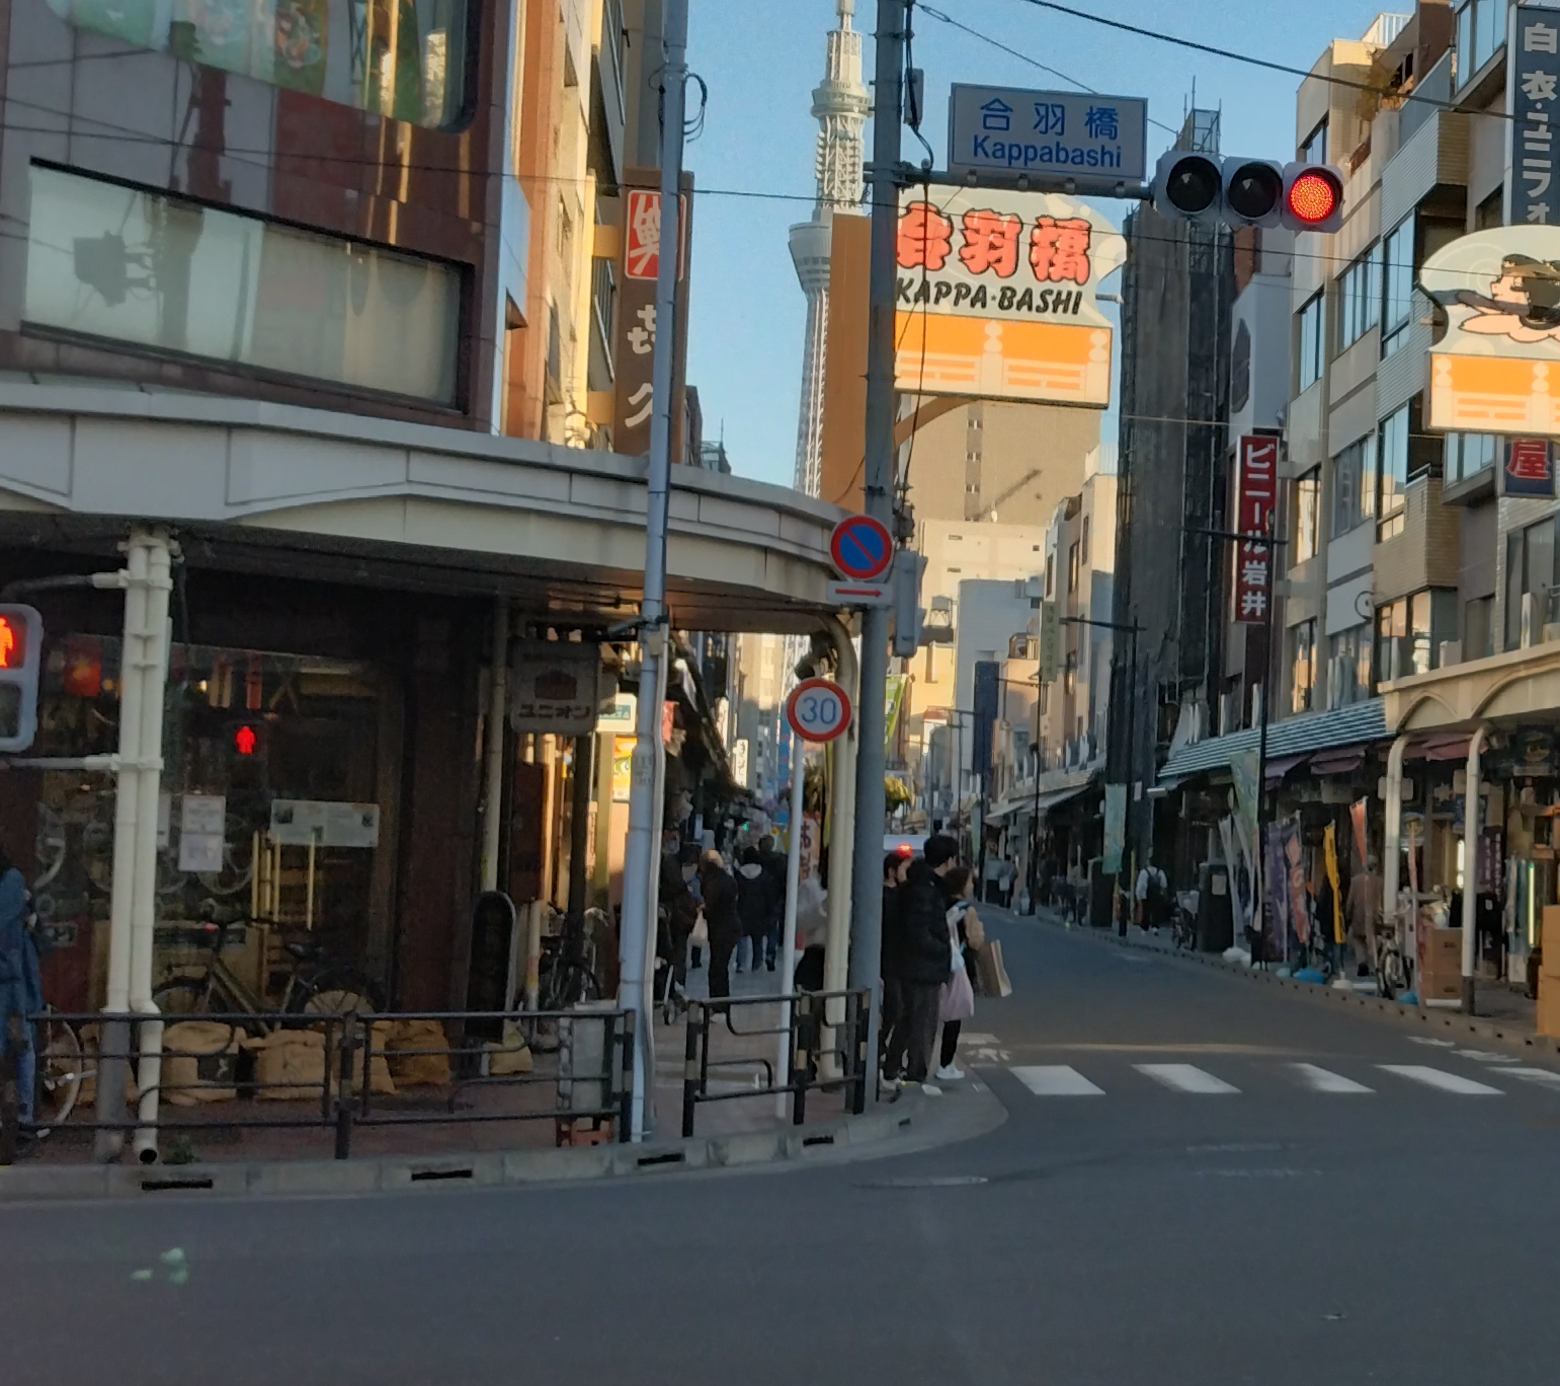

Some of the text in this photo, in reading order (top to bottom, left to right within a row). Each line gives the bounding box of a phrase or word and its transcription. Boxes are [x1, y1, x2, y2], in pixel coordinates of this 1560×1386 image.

[979, 97, 1120, 141] 合羽橋
[973, 134, 1122, 169] Kappabashi
[896, 200, 1092, 286] 合羽橋
[517, 704, 592, 719] ユニオン
[802, 696, 837, 725] 30
